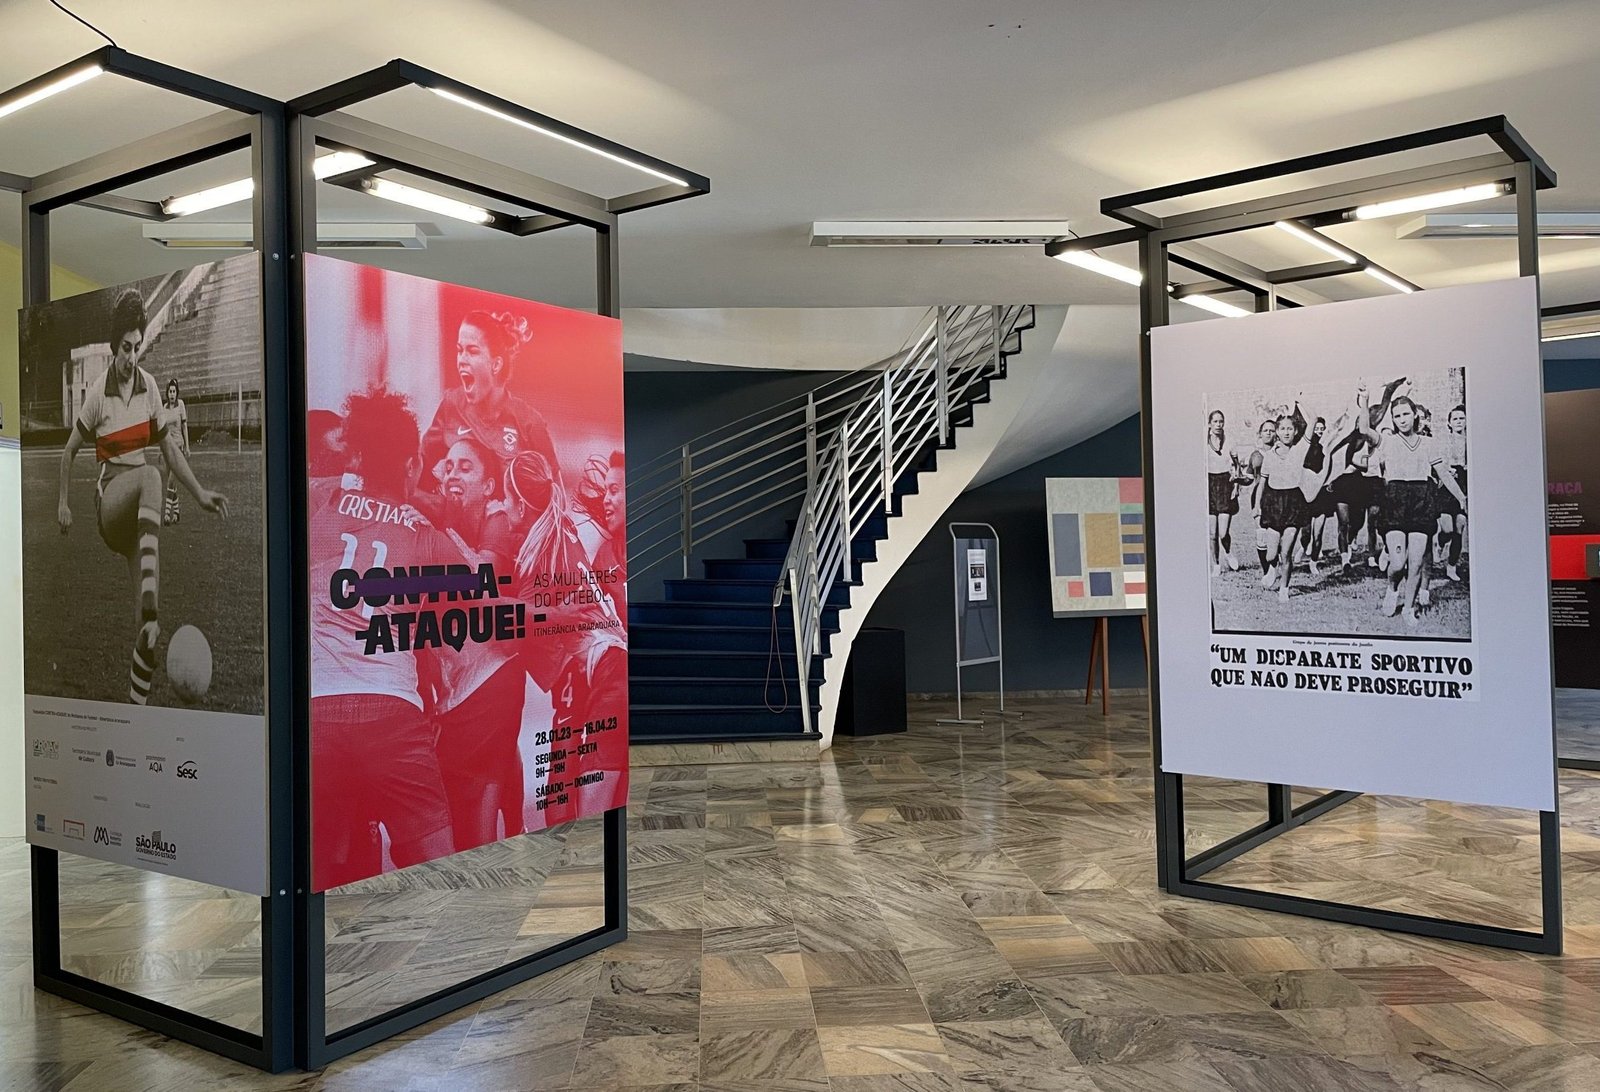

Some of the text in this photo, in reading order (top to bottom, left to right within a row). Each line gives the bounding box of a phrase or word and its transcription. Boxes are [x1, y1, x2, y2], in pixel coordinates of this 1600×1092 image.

[533, 569, 618, 588] AS MULHERES
[534, 592, 552, 608] DO
[533, 619, 620, 637] ITINERÂNCIA ARARAQUARA
[1210, 644, 1473, 676] “UM DISPARATE SPORTIVO
[1210, 668, 1473, 699] QUE NÃO DEVE PROSEGUIR”
[535, 726, 572, 746] 28.01.23
[584, 717, 618, 736] 16.04.23
[535, 748, 567, 766] SEGUNDA
[577, 742, 598, 756] SEXTA
[535, 782, 564, 798] SÁBADO
[574, 771, 605, 788] DOMINGO
[135, 834, 151, 849] SÃO
[151, 840, 177, 854] PAULO
